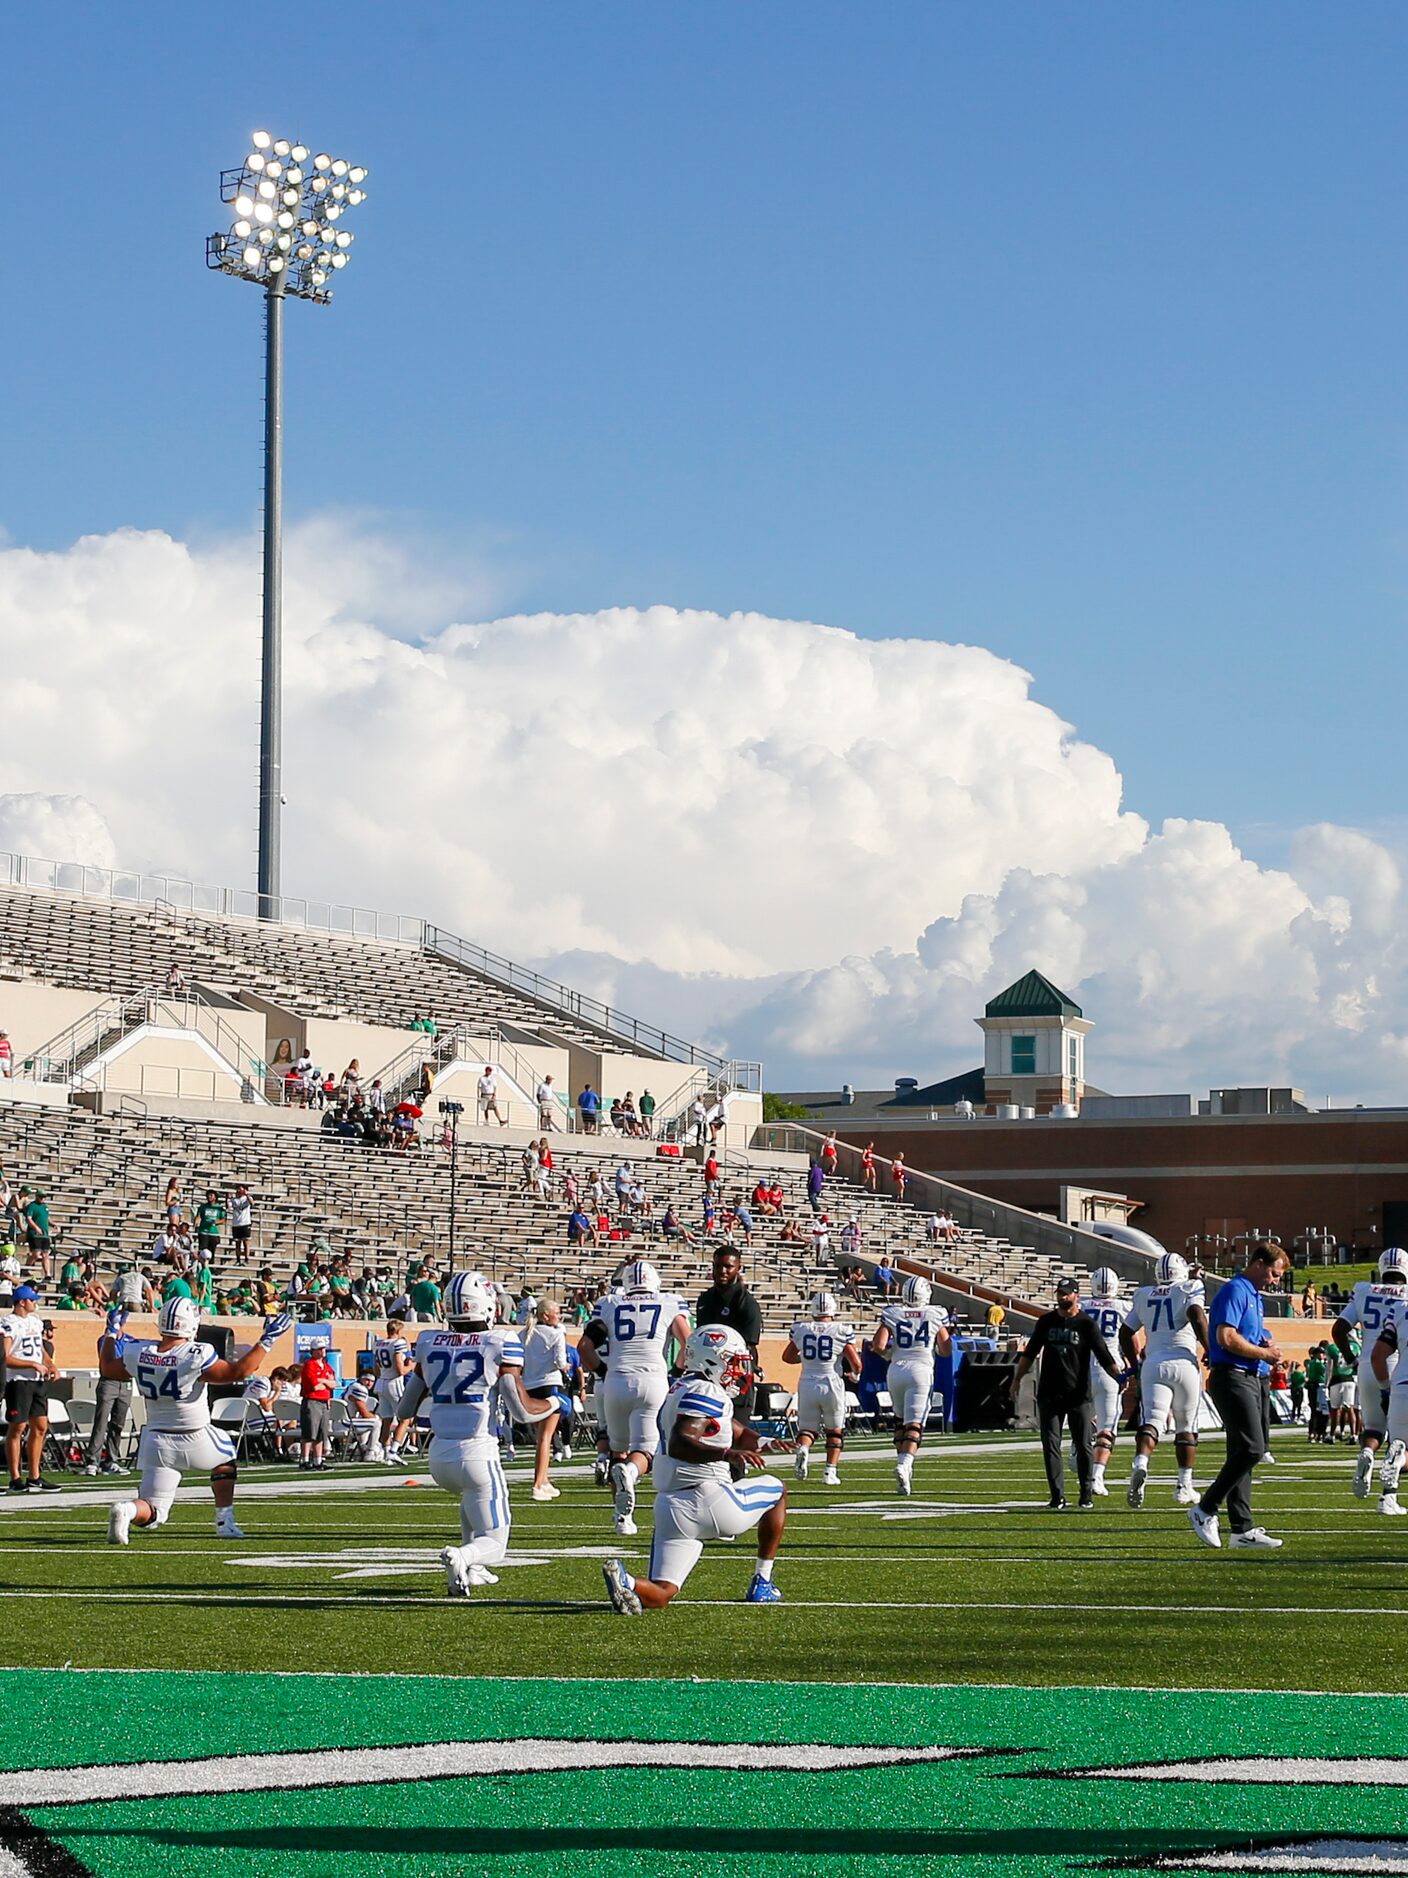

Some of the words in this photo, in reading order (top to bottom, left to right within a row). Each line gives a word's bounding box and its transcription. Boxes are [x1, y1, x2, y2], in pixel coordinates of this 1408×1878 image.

[614, 1304, 662, 1341] 67
[1147, 1298, 1175, 1332] 71
[21, 1337, 42, 1357] 55
[433, 1335, 463, 1346] EPTON
[465, 1334, 481, 1346] JR.
[803, 1334, 833, 1361] 68
[896, 1320, 930, 1348] 64
[139, 1353, 177, 1367] BISSINGER
[137, 1366, 182, 1400] 54
[427, 1351, 485, 1404] 22
